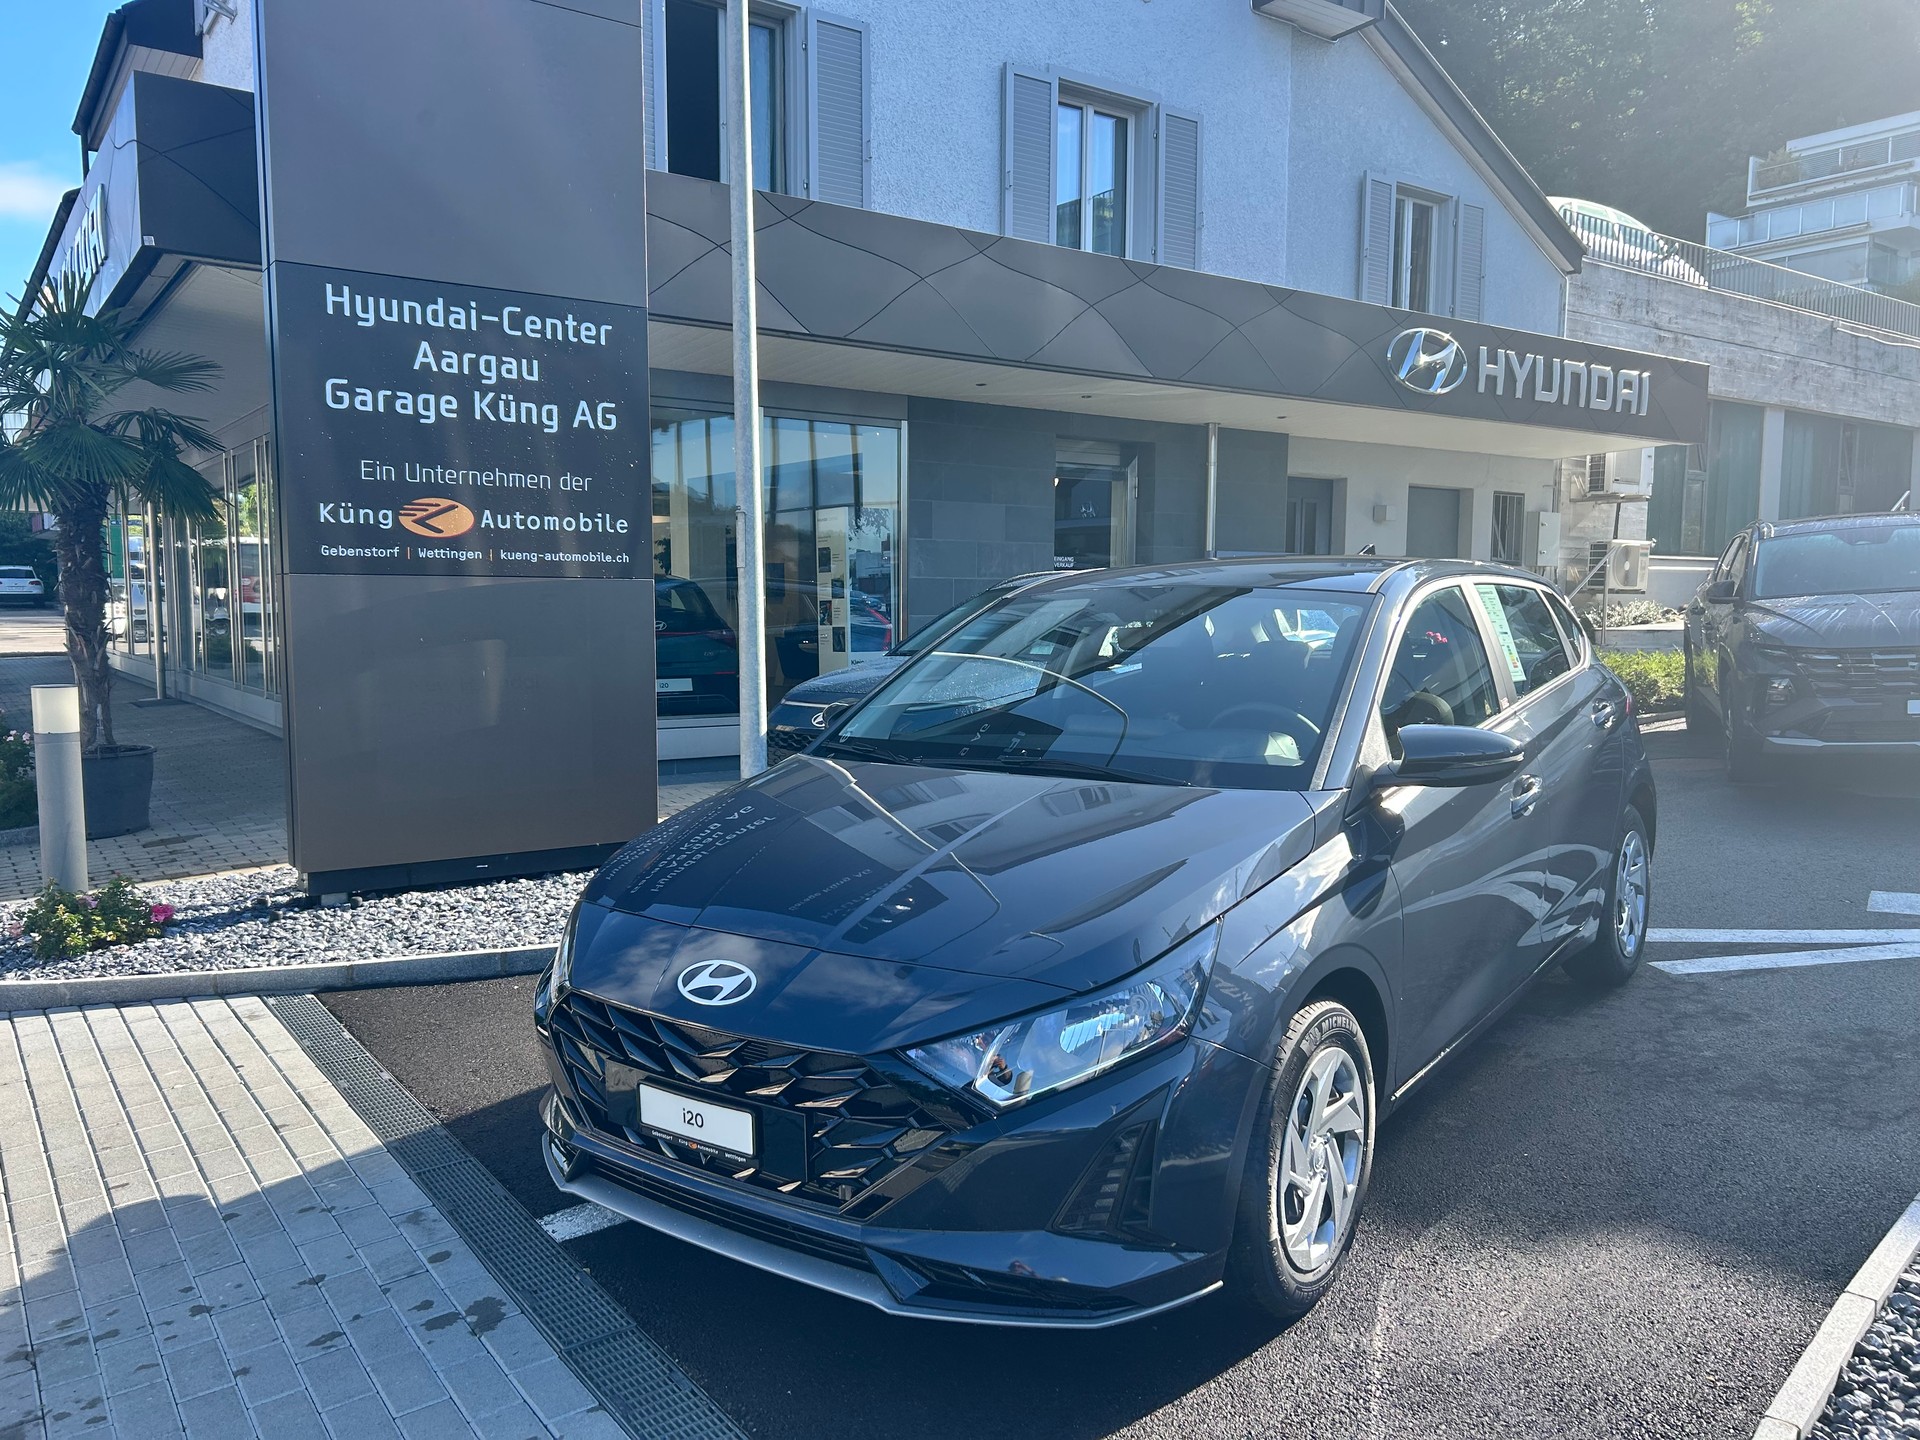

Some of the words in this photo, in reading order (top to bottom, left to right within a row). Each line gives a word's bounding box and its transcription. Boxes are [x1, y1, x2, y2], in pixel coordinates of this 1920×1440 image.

[325, 283, 612, 346] Hyundai-Center
[413, 341, 539, 384] Aargau
[1477, 345, 1651, 416] HYUNDAI
[325, 378, 458, 424] Garage
[474, 390, 558, 432] Küng
[573, 400, 617, 430] AG
[361, 460, 395, 482] Ein
[406, 462, 551, 490] Unternehmen
[560, 471, 592, 492] der
[319, 502, 393, 529] Küng
[481, 509, 629, 534] Automobile
[321, 545, 399, 558] Gebenstorf
[418, 548, 482, 560] Wettingen
[500, 550, 629, 563] kueng-automobile.ch
[1321, 1015, 1358, 1036] MICHELIN
[682, 1108, 704, 1128] i20
